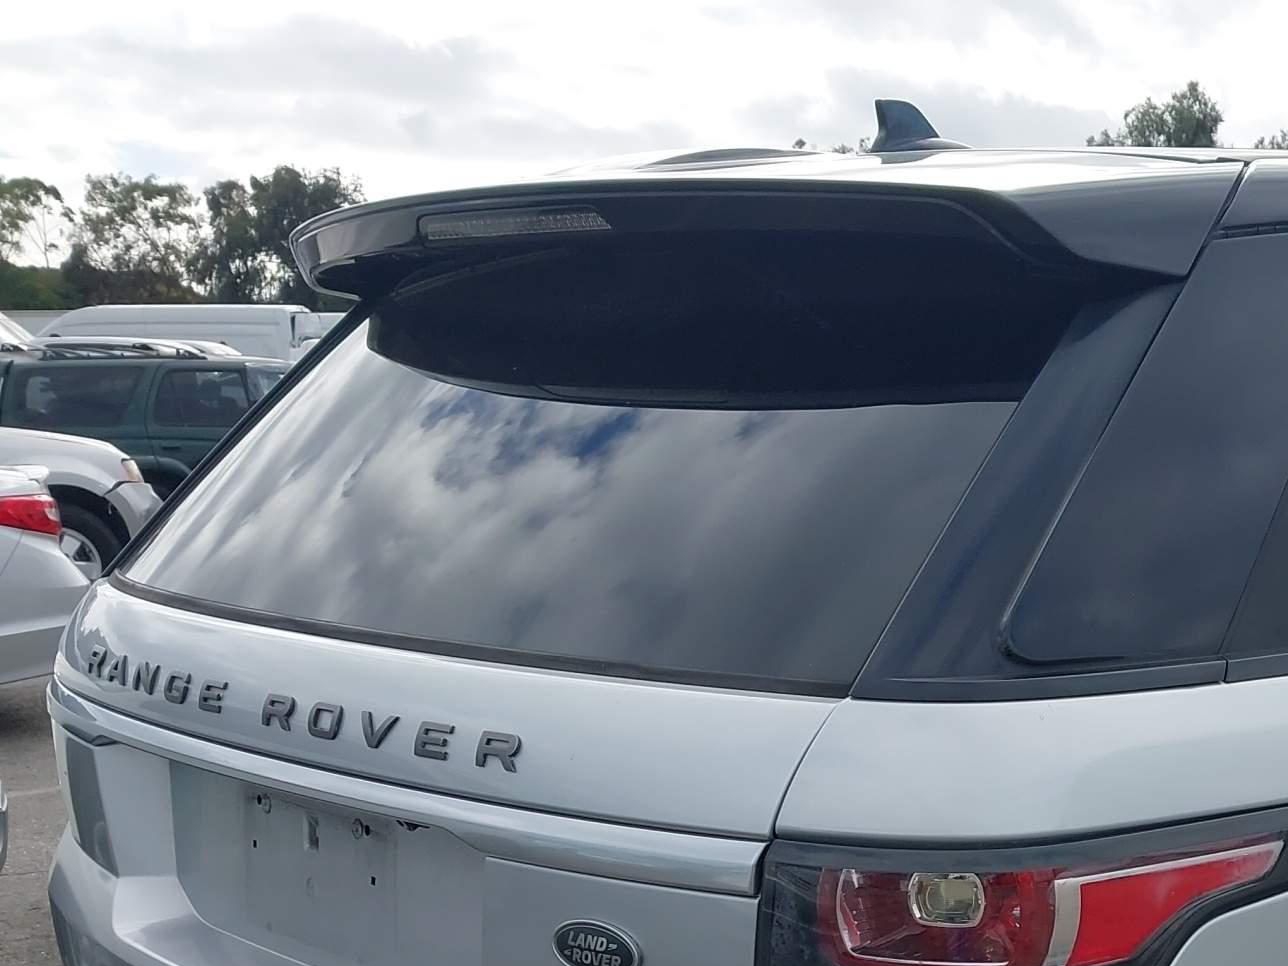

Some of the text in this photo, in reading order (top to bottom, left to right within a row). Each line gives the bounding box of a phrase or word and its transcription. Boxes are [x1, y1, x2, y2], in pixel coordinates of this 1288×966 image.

[86, 643, 524, 774] RANGE ROVER
[567, 930, 608, 952] LAND
